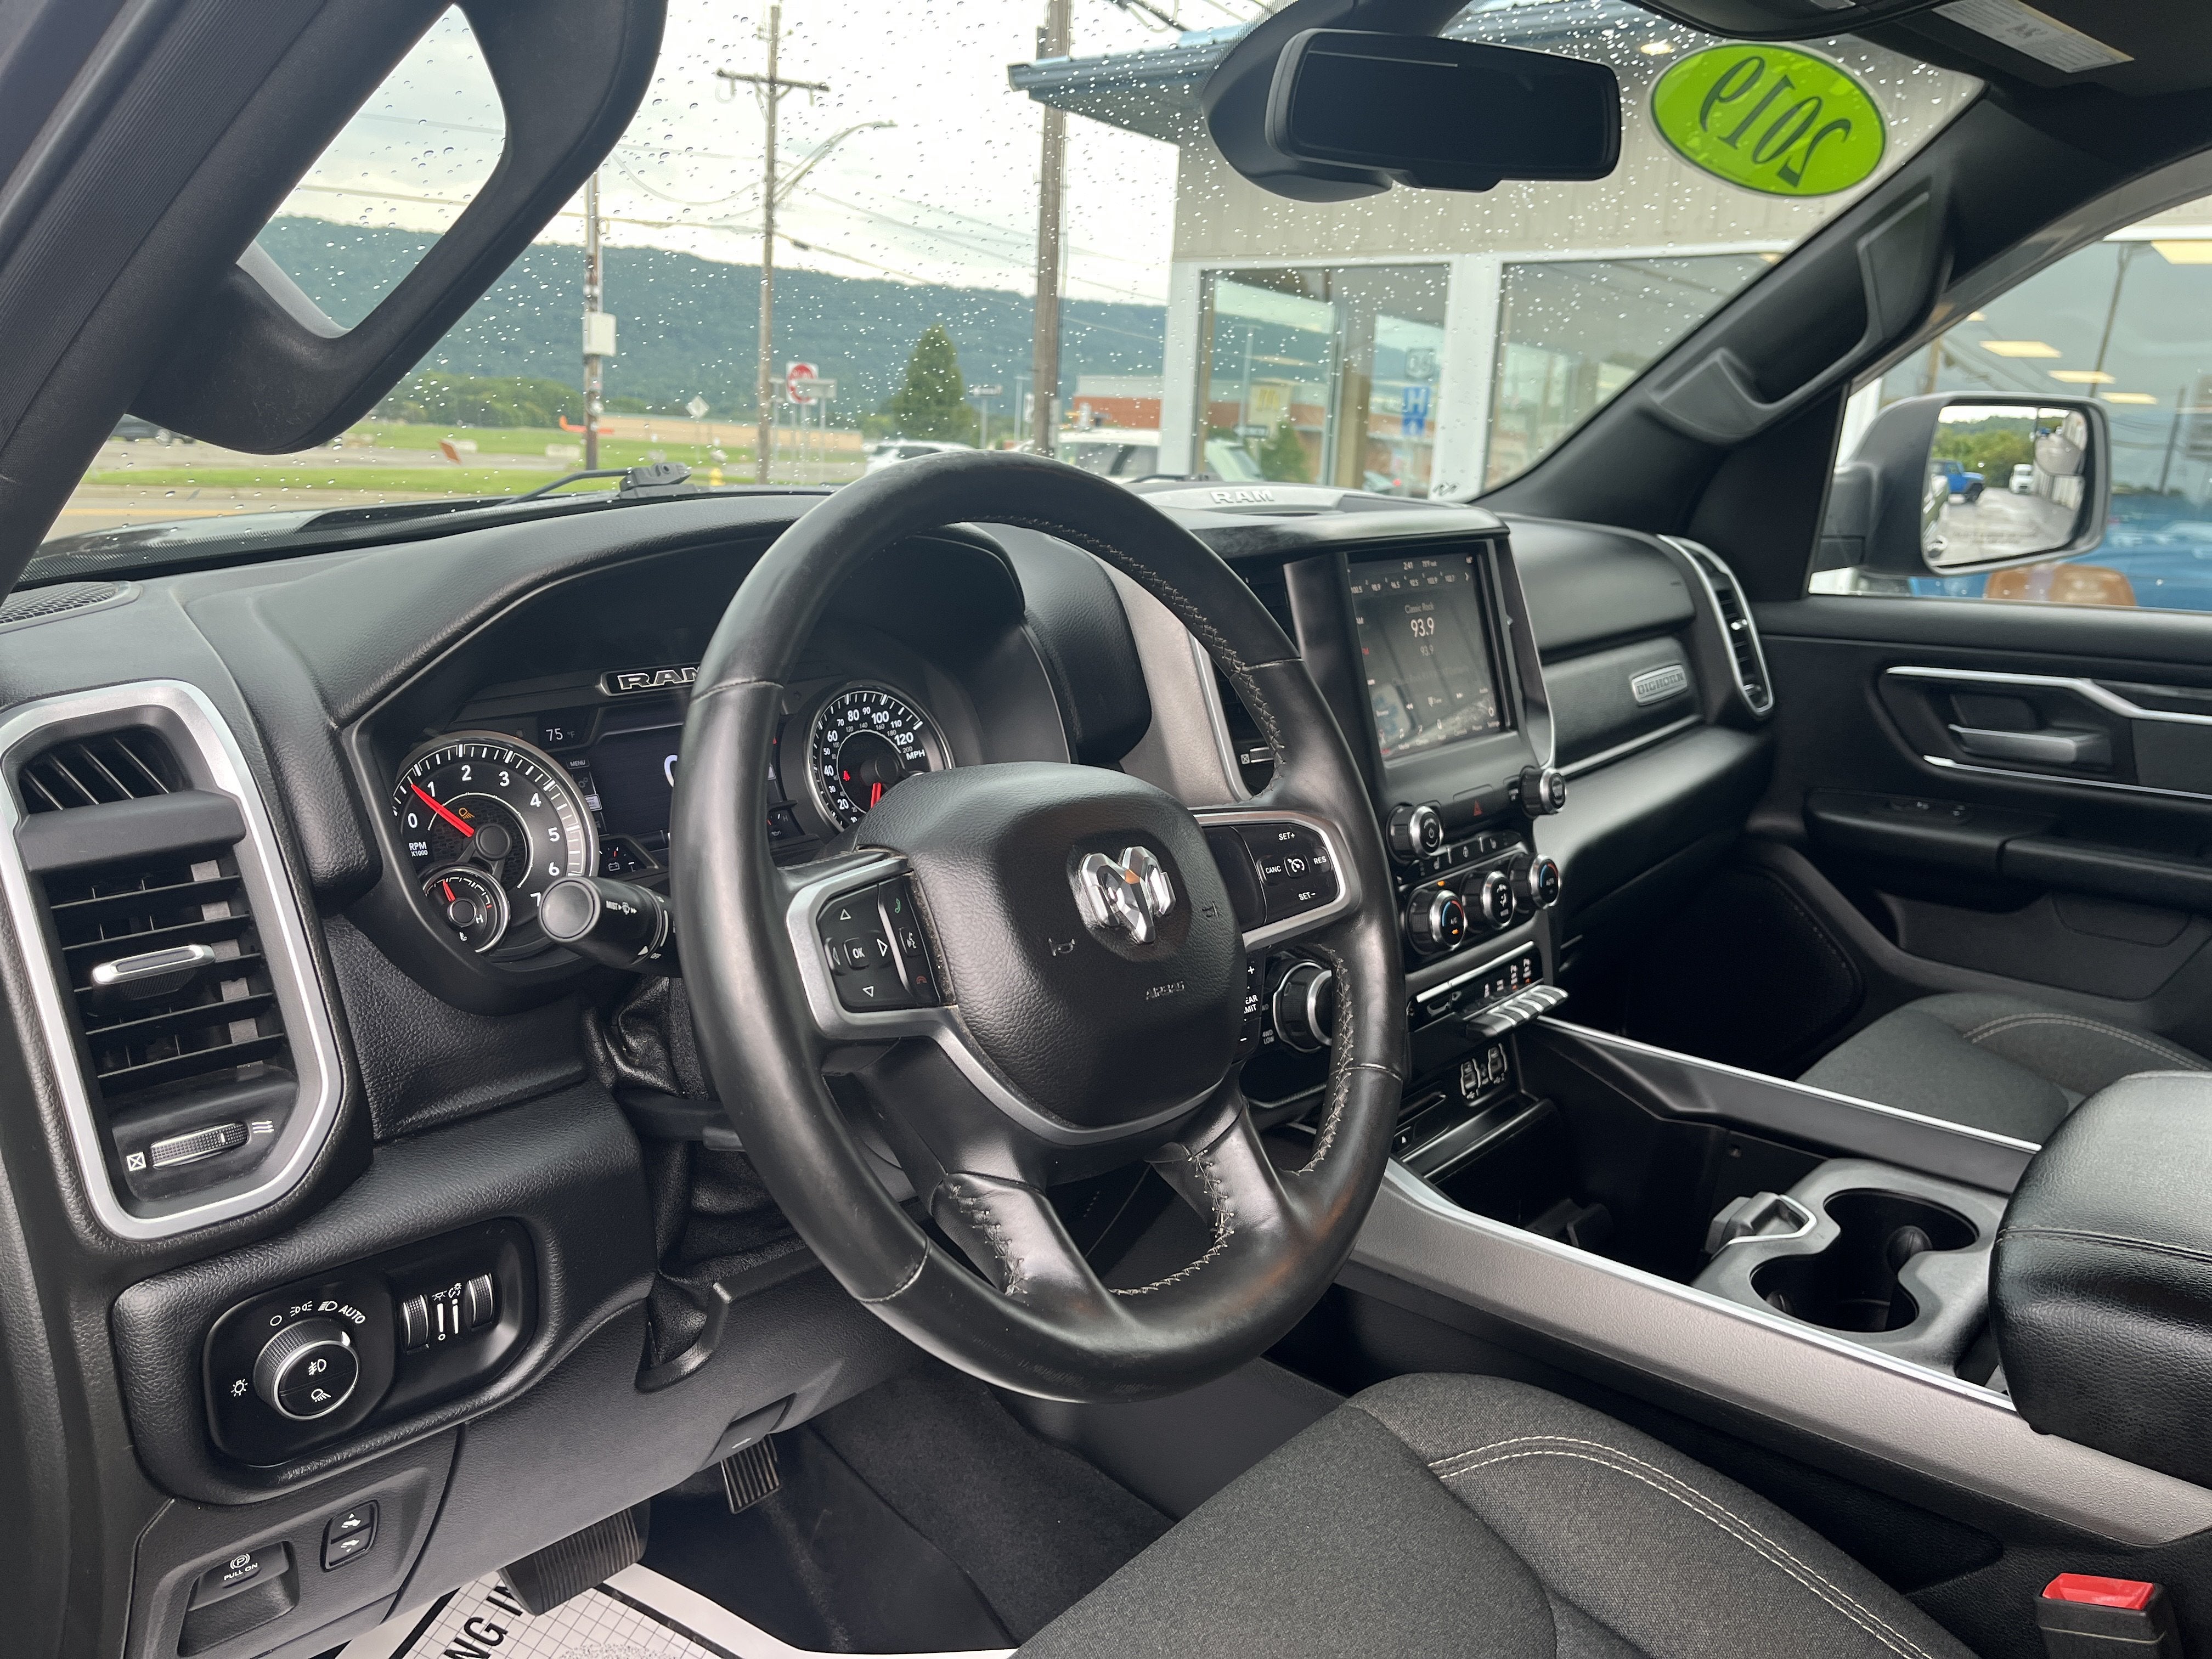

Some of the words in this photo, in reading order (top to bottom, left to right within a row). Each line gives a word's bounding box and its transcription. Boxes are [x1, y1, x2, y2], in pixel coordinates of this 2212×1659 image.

[1210, 489, 1274, 504] RAM
[1410, 617, 1435, 638] 93.9
[1420, 644, 1434, 657] 93.9
[847, 709, 860, 722] 80
[862, 706, 871, 715] 90
[837, 719, 845, 727] 70
[871, 710, 890, 725] 100
[890, 719, 902, 729] 110
[545, 727, 563, 741] 75
[827, 730, 838, 742] 60
[894, 731, 914, 746] 120
[823, 747, 831, 755] 50
[902, 746, 913, 754] 200
[905, 749, 926, 761] MPH
[461, 765, 472, 781] 2
[823, 765, 834, 777] 40
[498, 771, 510, 787] 3
[427, 781, 436, 797] 1
[828, 785, 836, 793] 30
[529, 793, 541, 808] 4
[837, 798, 849, 810] 20
[408, 812, 418, 828] 0
[548, 827, 560, 842] 5
[409, 841, 427, 851] RPM
[1313, 856, 1327, 865] RES
[548, 862, 560, 876] 6
[1265, 865, 1282, 874] CANC
[531, 892, 541, 907] 7
[476, 914, 484, 924] H
[852, 947, 865, 959] OK
[1245, 995, 1258, 1005] EAR
[338, 1305, 366, 1324] AUTO
[224, 1570, 243, 1581] PULL
[245, 1562, 258, 1572] ON
